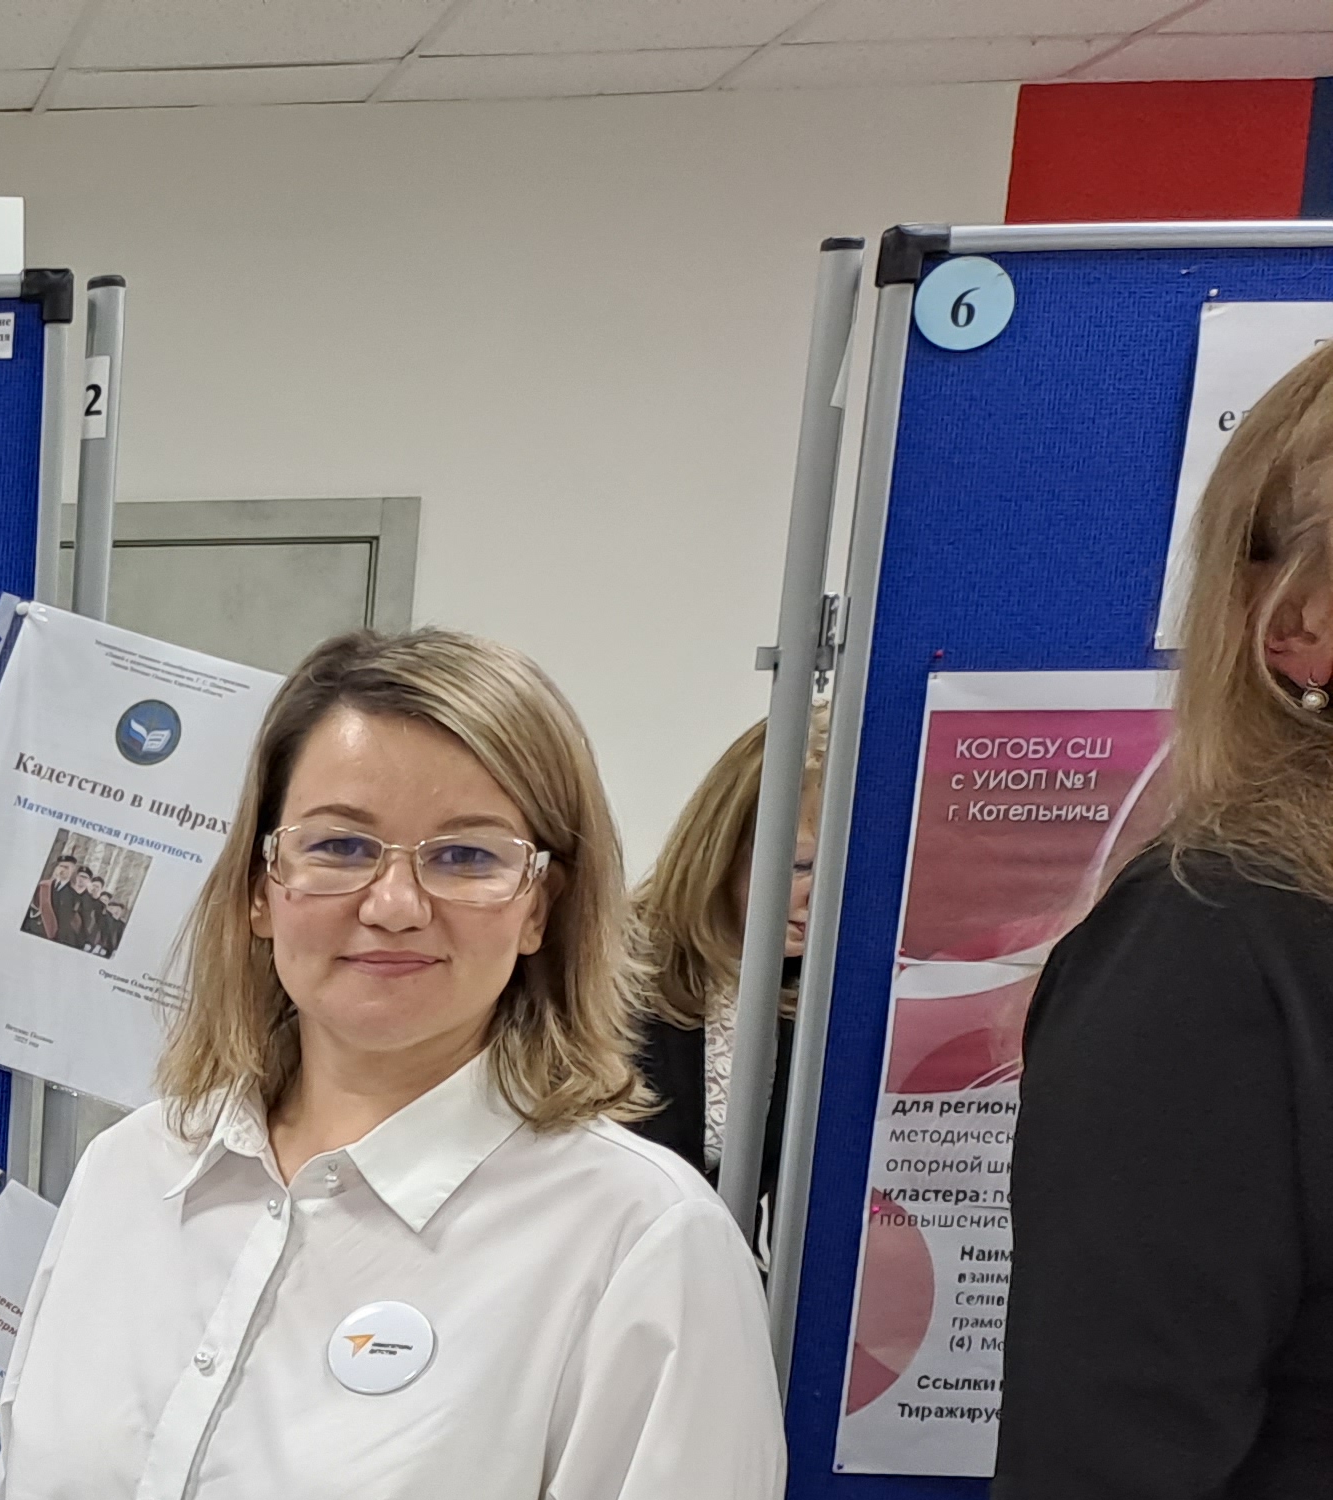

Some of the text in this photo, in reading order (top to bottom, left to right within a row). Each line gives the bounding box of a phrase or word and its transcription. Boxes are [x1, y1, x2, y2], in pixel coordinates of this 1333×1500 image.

[950, 287, 981, 328] 6
[84, 384, 103, 417] 2
[956, 737, 1112, 759] КОГОБУ СШ
[950, 768, 1098, 791] с УИОП №1
[13, 751, 231, 836] Кадетство в цифрах
[968, 801, 1109, 822] Котельнича
[13, 794, 203, 864] Математическая грамотность
[891, 1100, 933, 1117] для
[886, 1156, 982, 1176] опорной
[882, 1187, 988, 1204] кластера:
